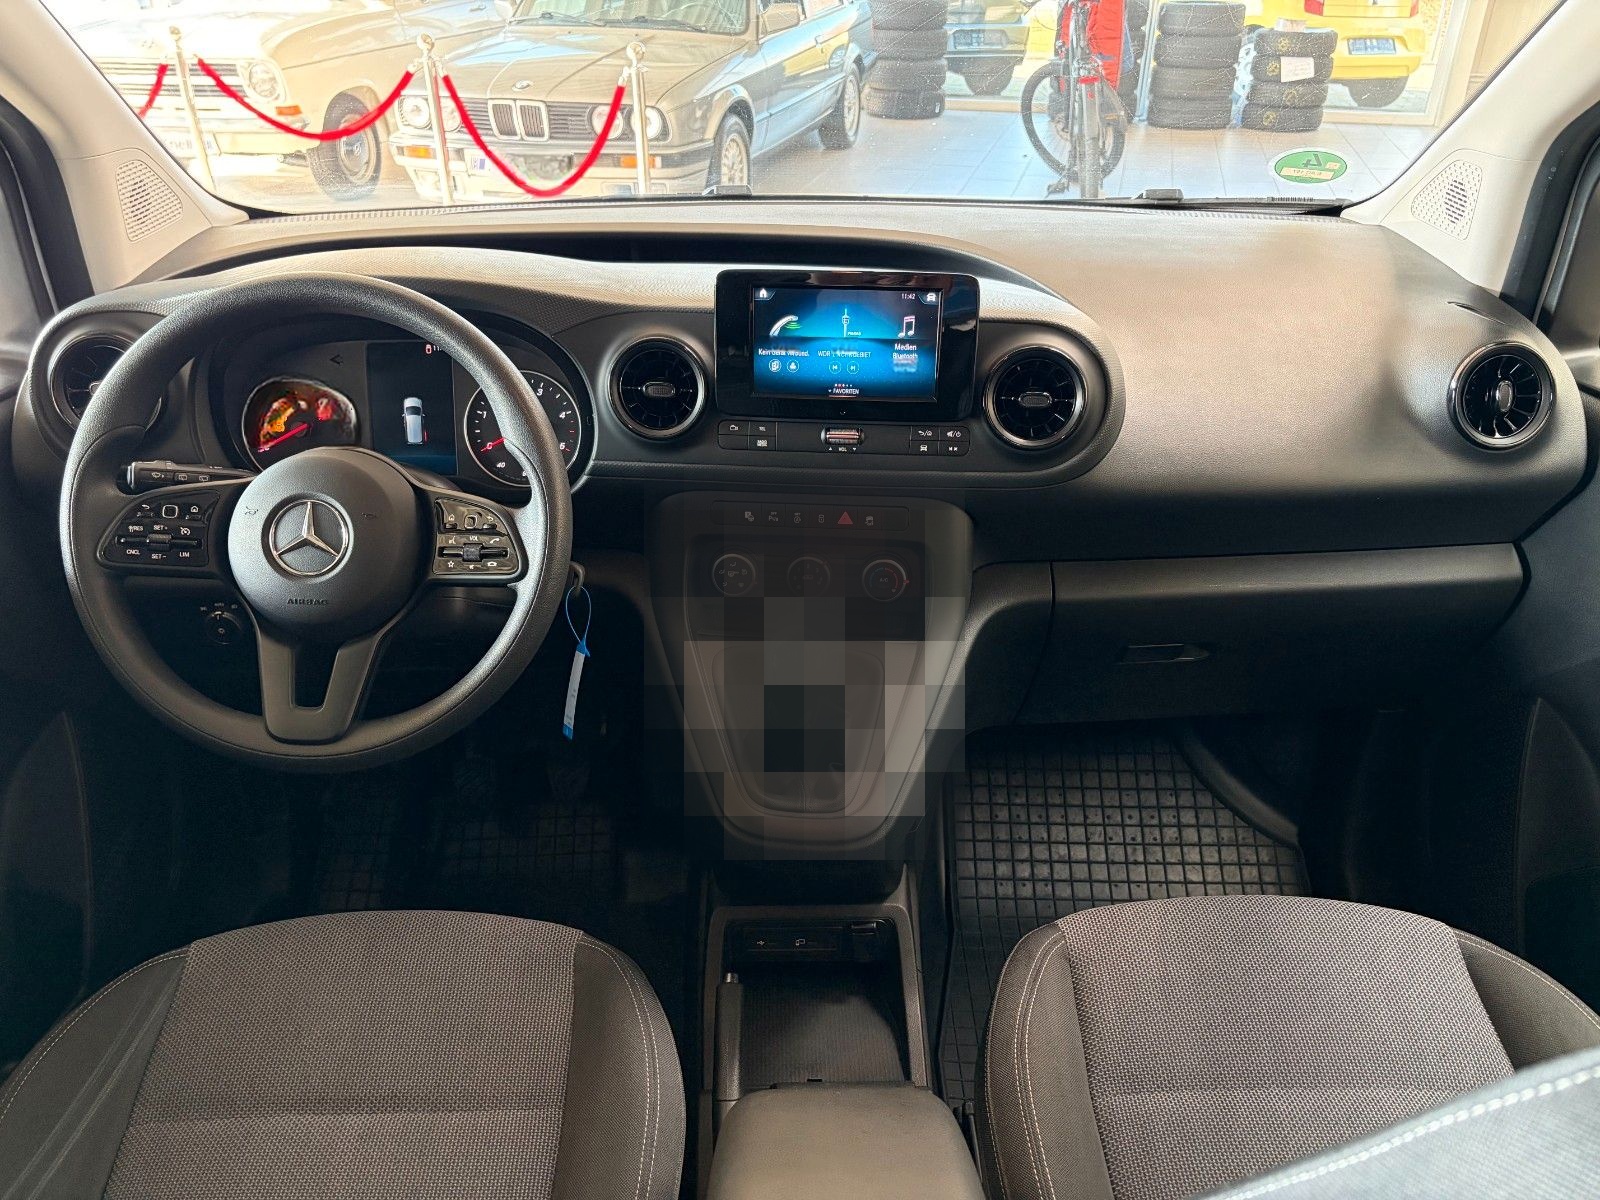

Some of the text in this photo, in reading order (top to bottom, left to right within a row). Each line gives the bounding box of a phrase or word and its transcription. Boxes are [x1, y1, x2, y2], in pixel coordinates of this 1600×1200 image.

[894, 343, 917, 351] Medien
[758, 348, 771, 356] Kein
[536, 388, 543, 396] 3
[559, 411, 566, 419] 4
[286, 598, 329, 606] AIRBAG
